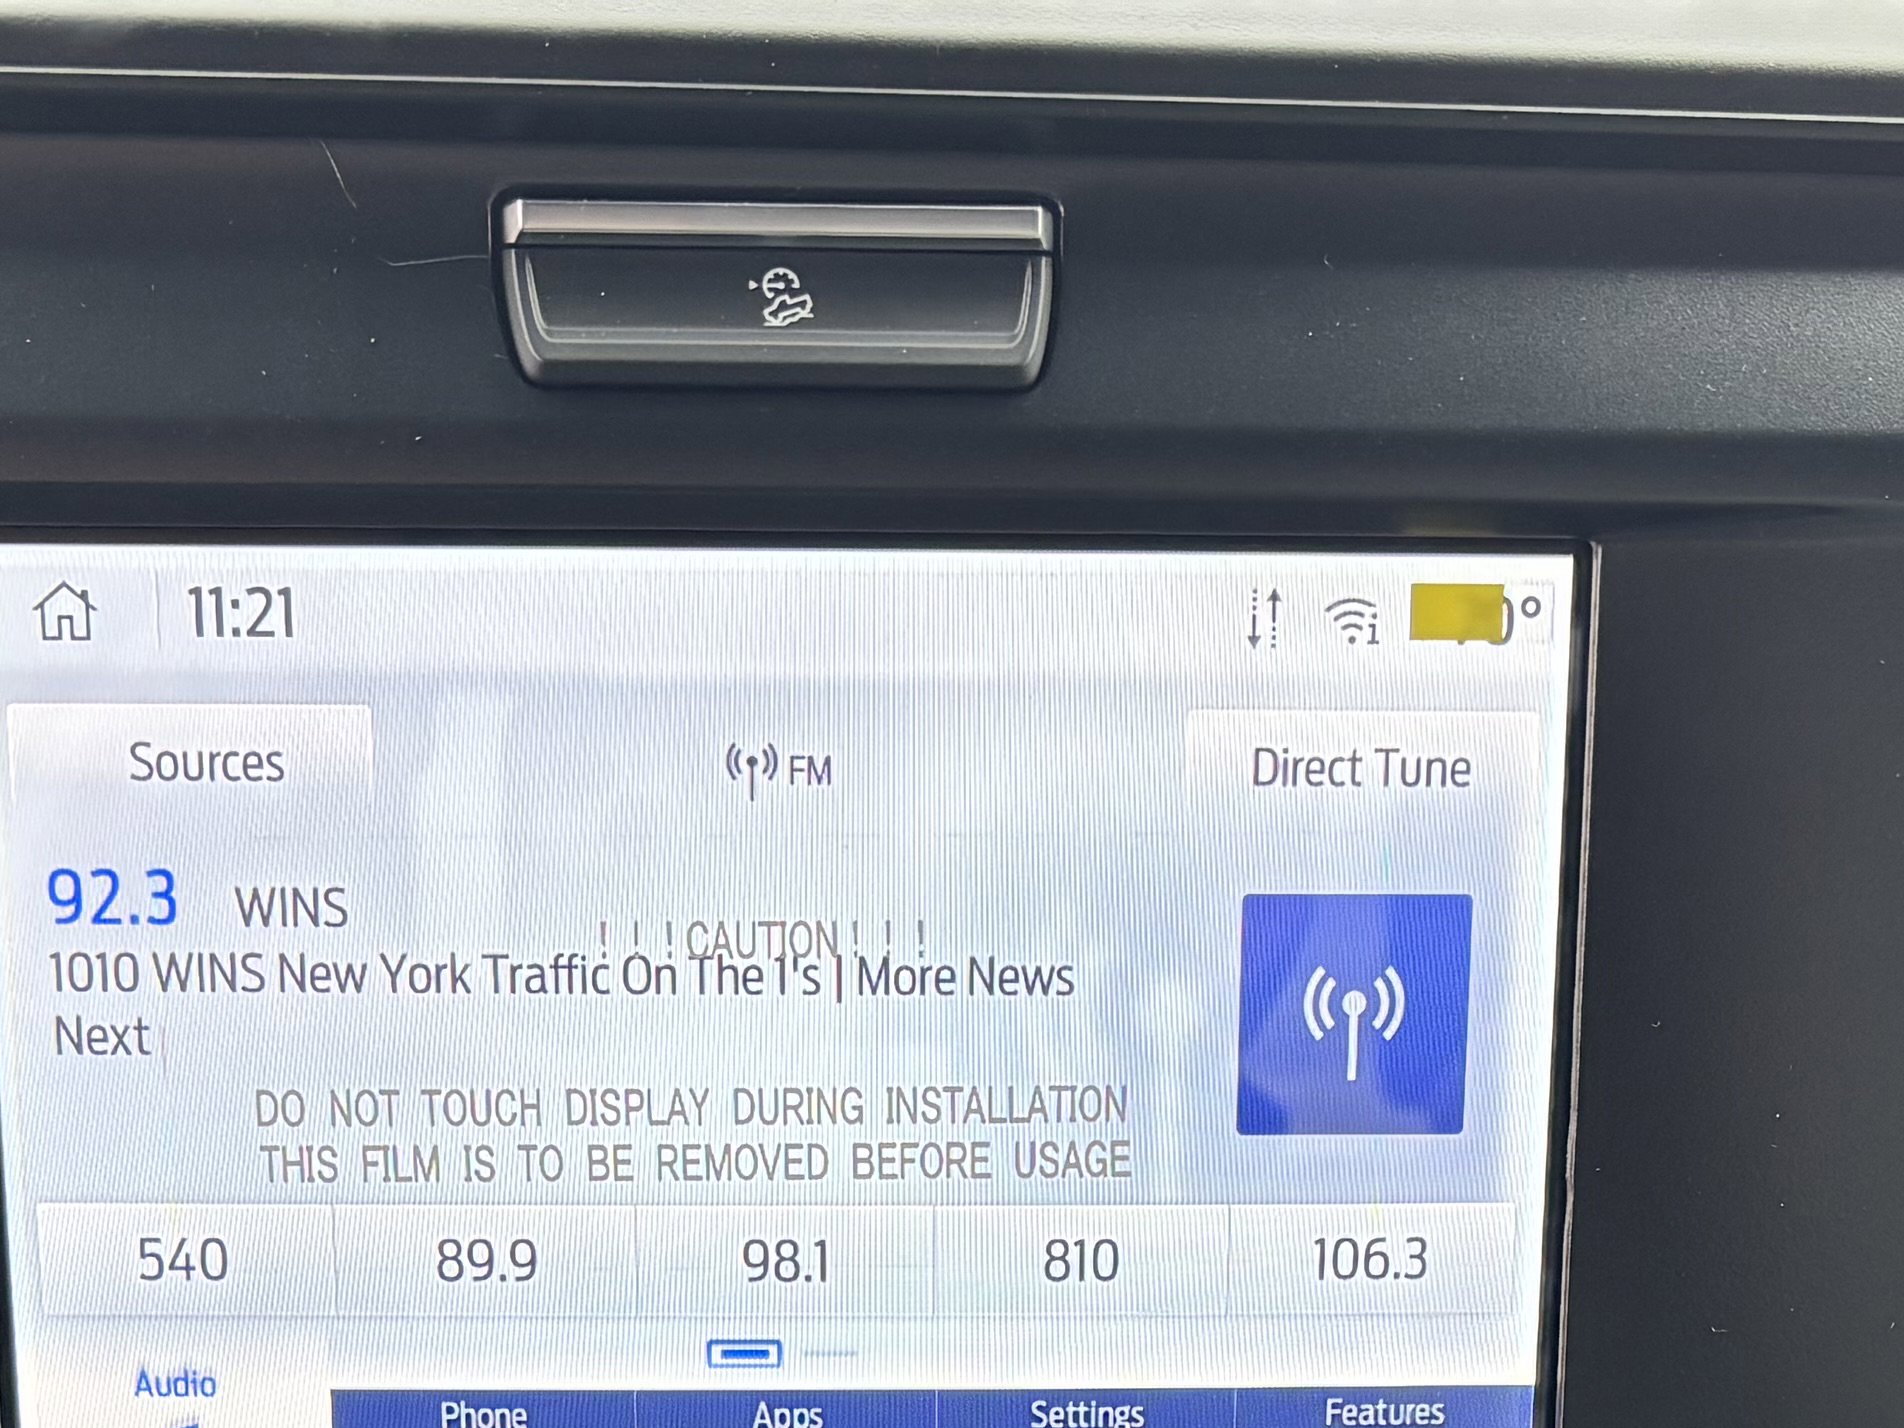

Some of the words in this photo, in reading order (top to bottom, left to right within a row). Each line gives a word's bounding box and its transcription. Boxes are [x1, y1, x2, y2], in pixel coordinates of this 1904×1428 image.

[188, 586, 293, 638] 11:21
[129, 741, 285, 783] Sources
[789, 755, 832, 786] FM
[1252, 747, 1363, 788] Direct
[1374, 747, 1471, 788] Tune
[48, 868, 177, 926] 92.3
[234, 886, 348, 928] WINS
[686, 919, 838, 959] CAUTION
[49, 951, 140, 993] 1010
[151, 951, 266, 993] WINS
[278, 952, 368, 994] New
[379, 952, 472, 995] York
[481, 951, 610, 995] Traffic
[622, 953, 677, 996] On
[688, 953, 765, 996] The
[774, 953, 822, 996] 1's
[857, 954, 956, 997] More
[968, 955, 1075, 997] News
[55, 1015, 151, 1056] Next
[255, 1088, 306, 1128] DO
[329, 1088, 400, 1128] NOT
[420, 1088, 542, 1128] TOUCH
[565, 1087, 710, 1127] DISPLAY
[732, 1086, 864, 1126] DURING
[886, 1083, 1128, 1125] INSTALLATION
[259, 1144, 339, 1184] THIS
[362, 1144, 440, 1184] FILM
[463, 1144, 496, 1183] IS
[516, 1143, 564, 1183] TO
[587, 1143, 634, 1182] BE
[656, 1142, 829, 1182] REMOVED
[852, 1140, 993, 1180] BEFORE
[1014, 1139, 1132, 1179] USAGE
[139, 1237, 228, 1282] 540
[437, 1238, 537, 1283] 89.9
[743, 1239, 827, 1283] 98.1
[1044, 1238, 1119, 1283] 810
[1314, 1236, 1427, 1281] 106.3
[134, 1368, 217, 1398] Audio
[1325, 1398, 1445, 1426] Features
